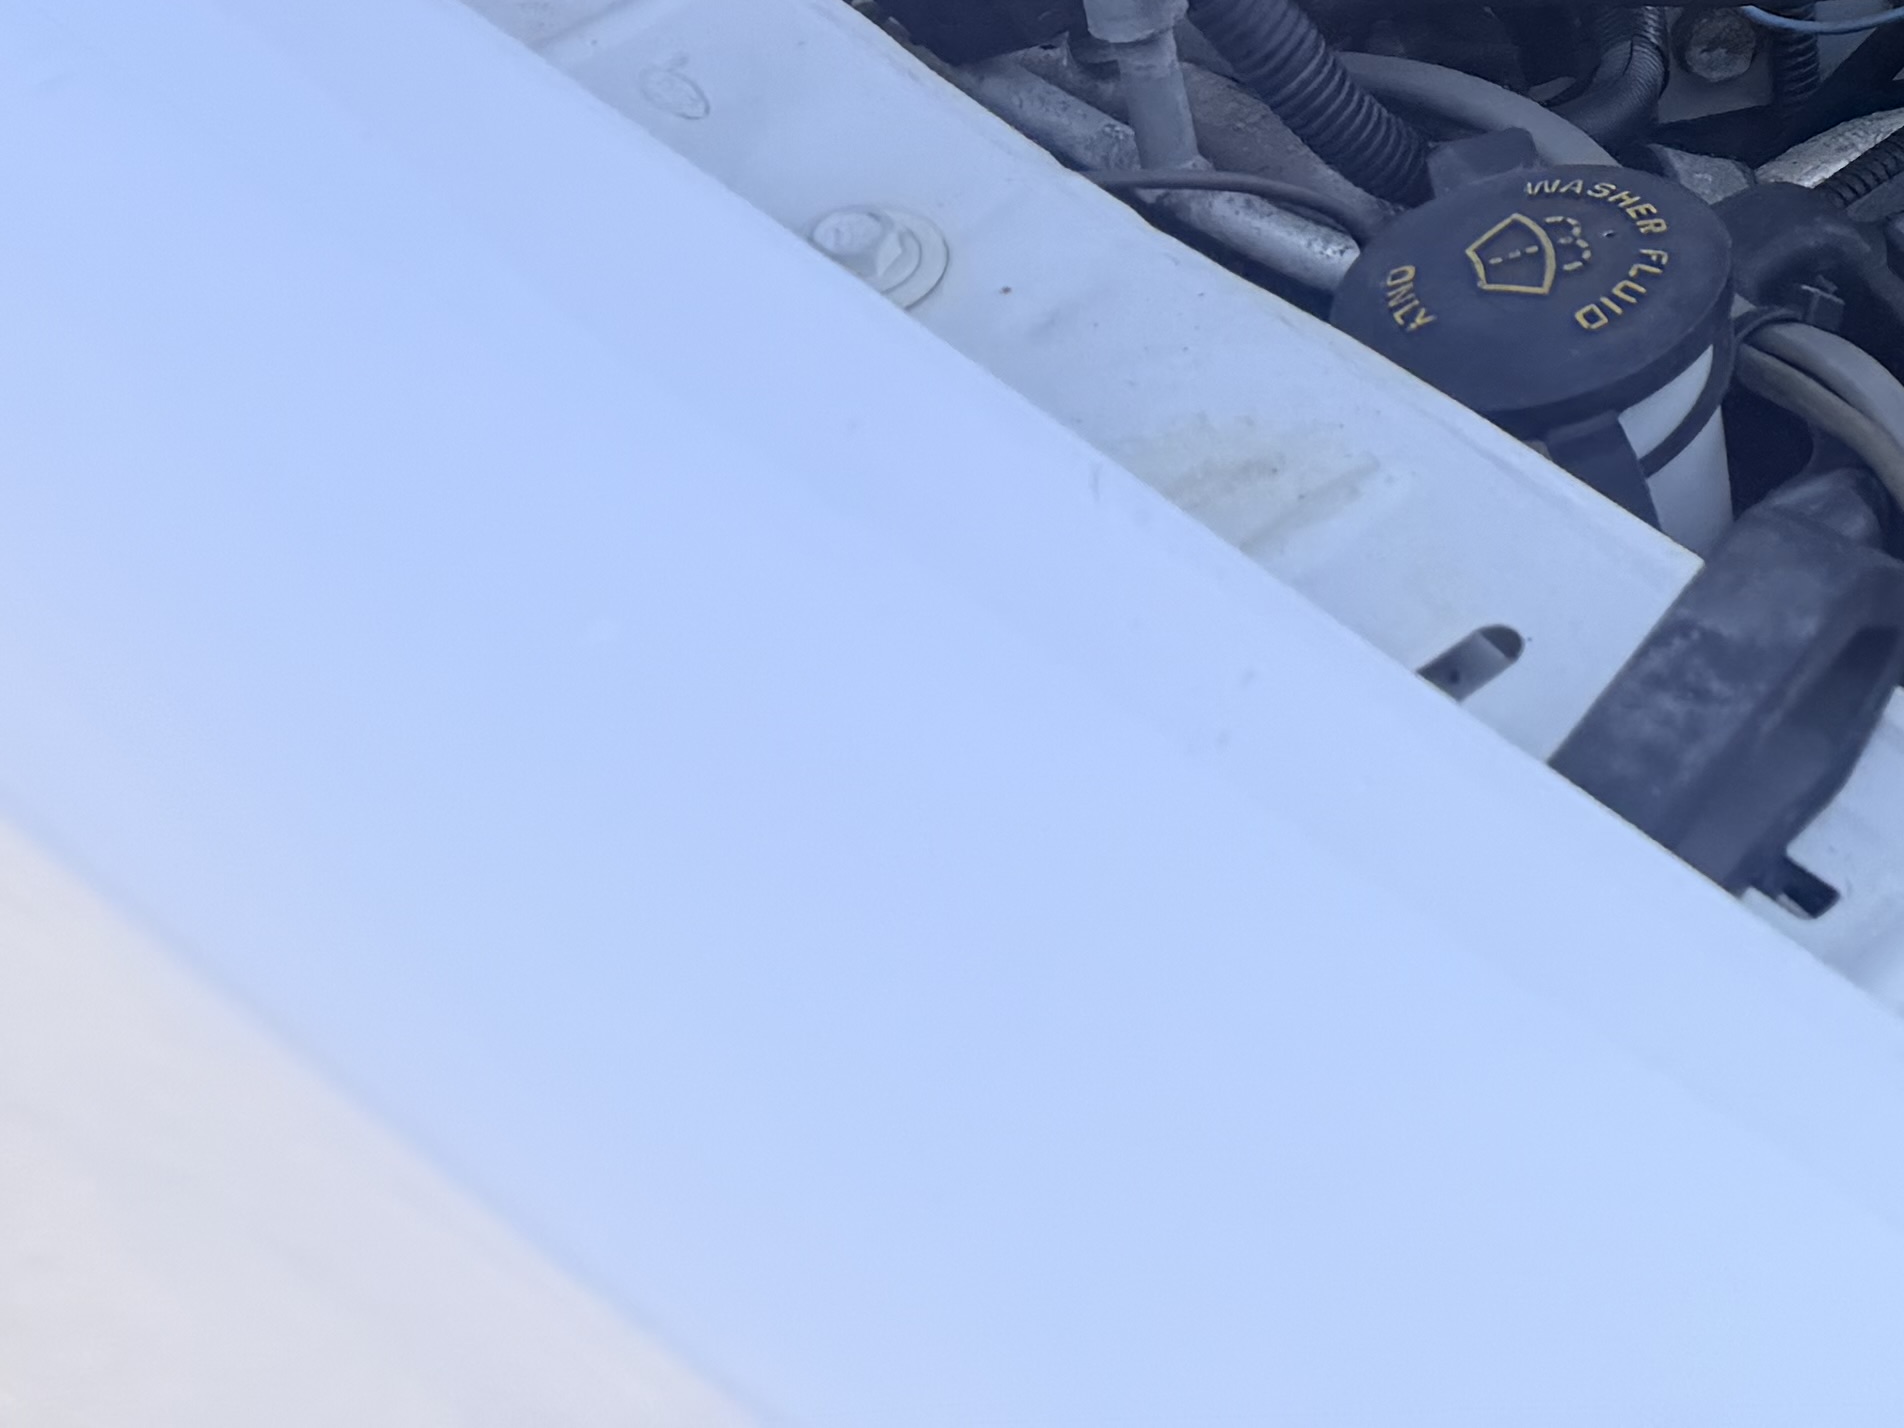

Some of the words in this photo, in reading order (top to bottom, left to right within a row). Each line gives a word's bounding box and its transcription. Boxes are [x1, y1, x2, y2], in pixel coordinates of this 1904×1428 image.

[1525, 179, 1669, 236] WASHER
[1385, 264, 1436, 333] ONLY
[1575, 248, 1670, 331] FLUID
